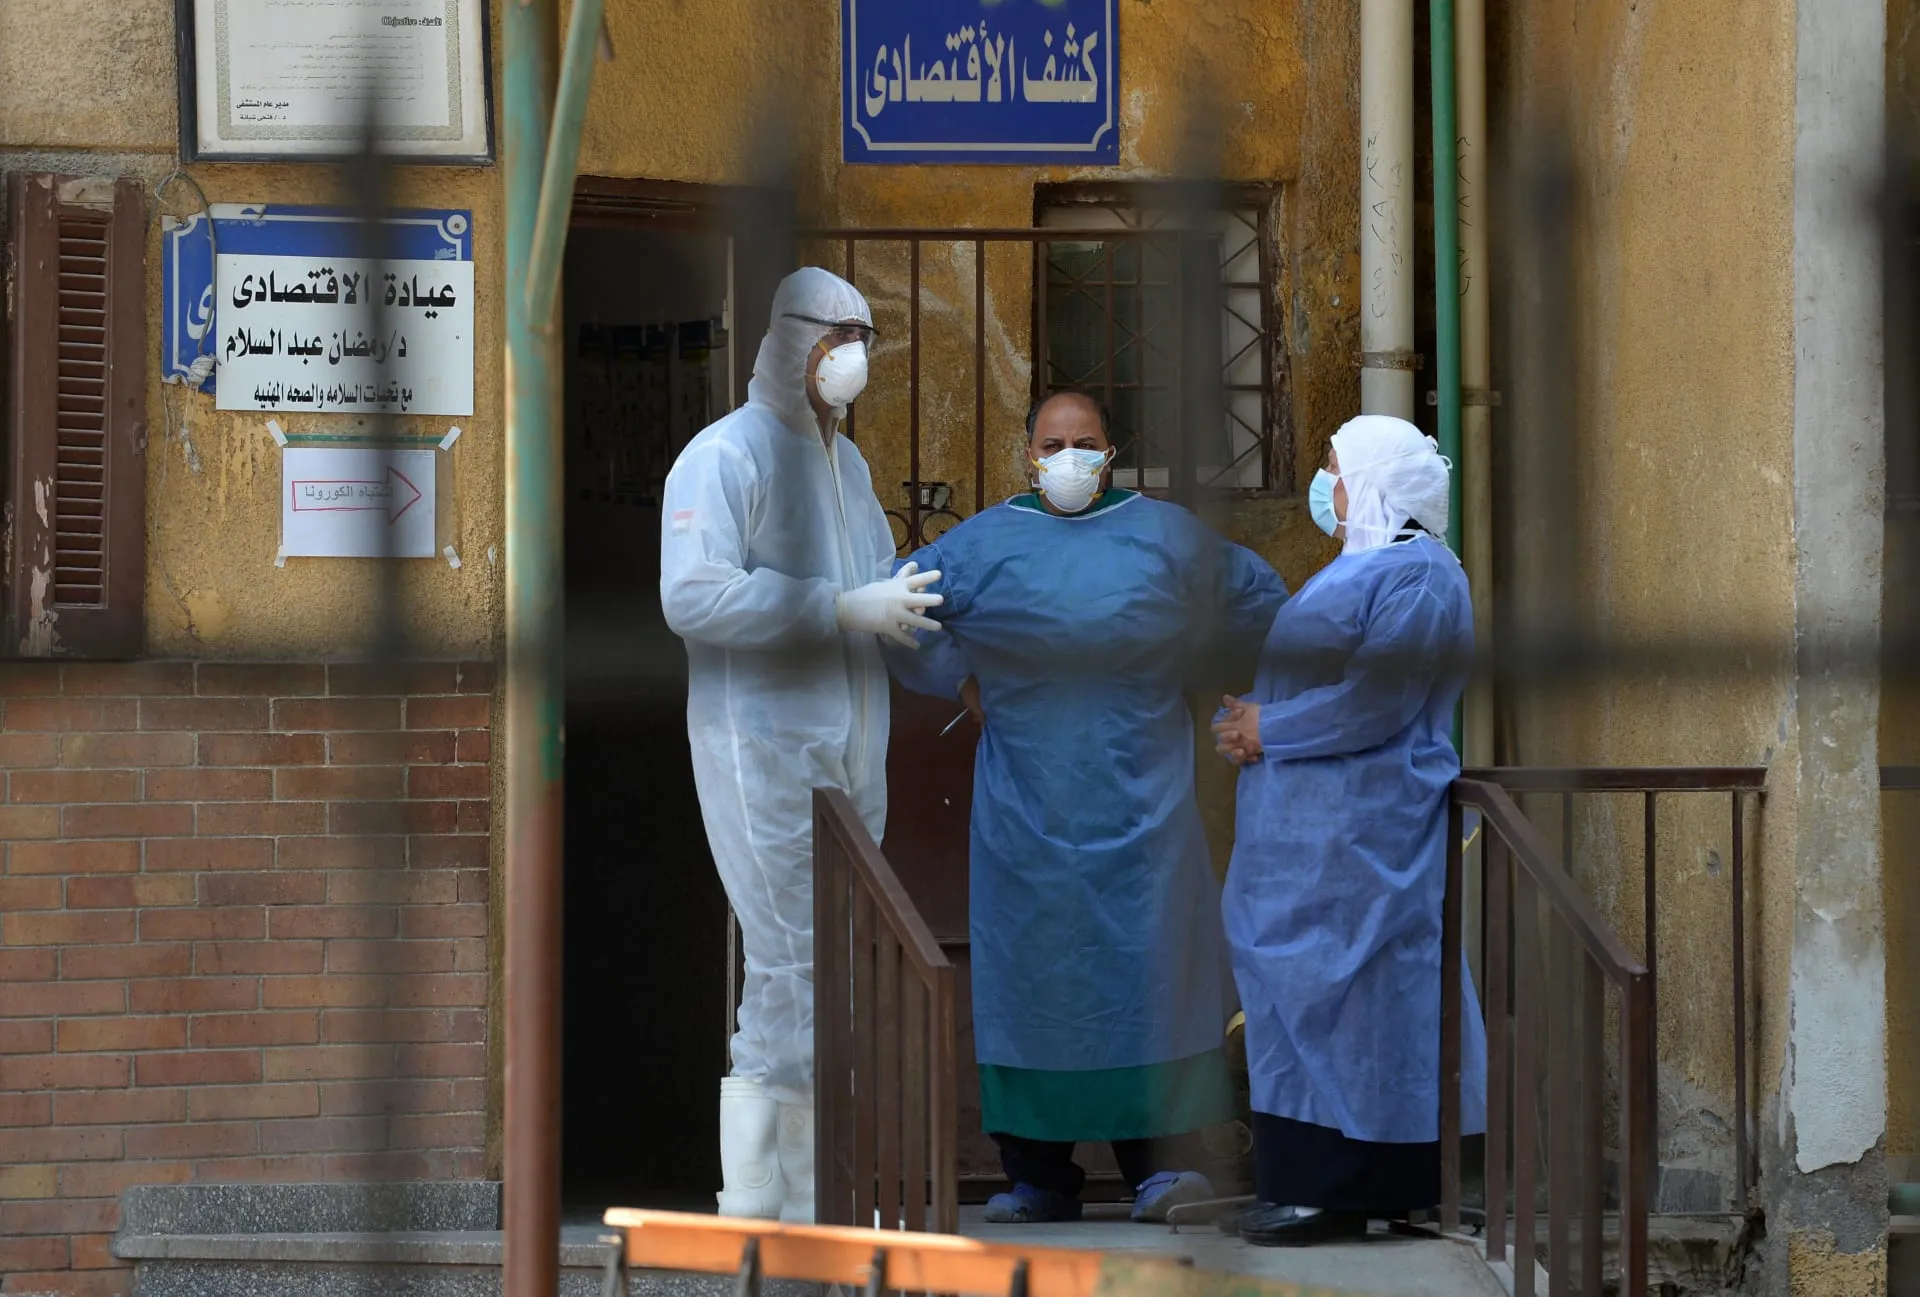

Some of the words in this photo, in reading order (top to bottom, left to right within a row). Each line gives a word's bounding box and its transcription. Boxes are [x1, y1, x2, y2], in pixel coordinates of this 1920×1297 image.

[865, 20, 1016, 118] الأقتصادى
[1022, 21, 1098, 103] كشف
[233, 267, 369, 309] الاقتصادى
[384, 273, 456, 319] عيادة
[226, 326, 282, 363] السلام
[287, 331, 324, 365] عبد
[401, 386, 413, 411] مع
[305, 485, 353, 500] الكورونا
